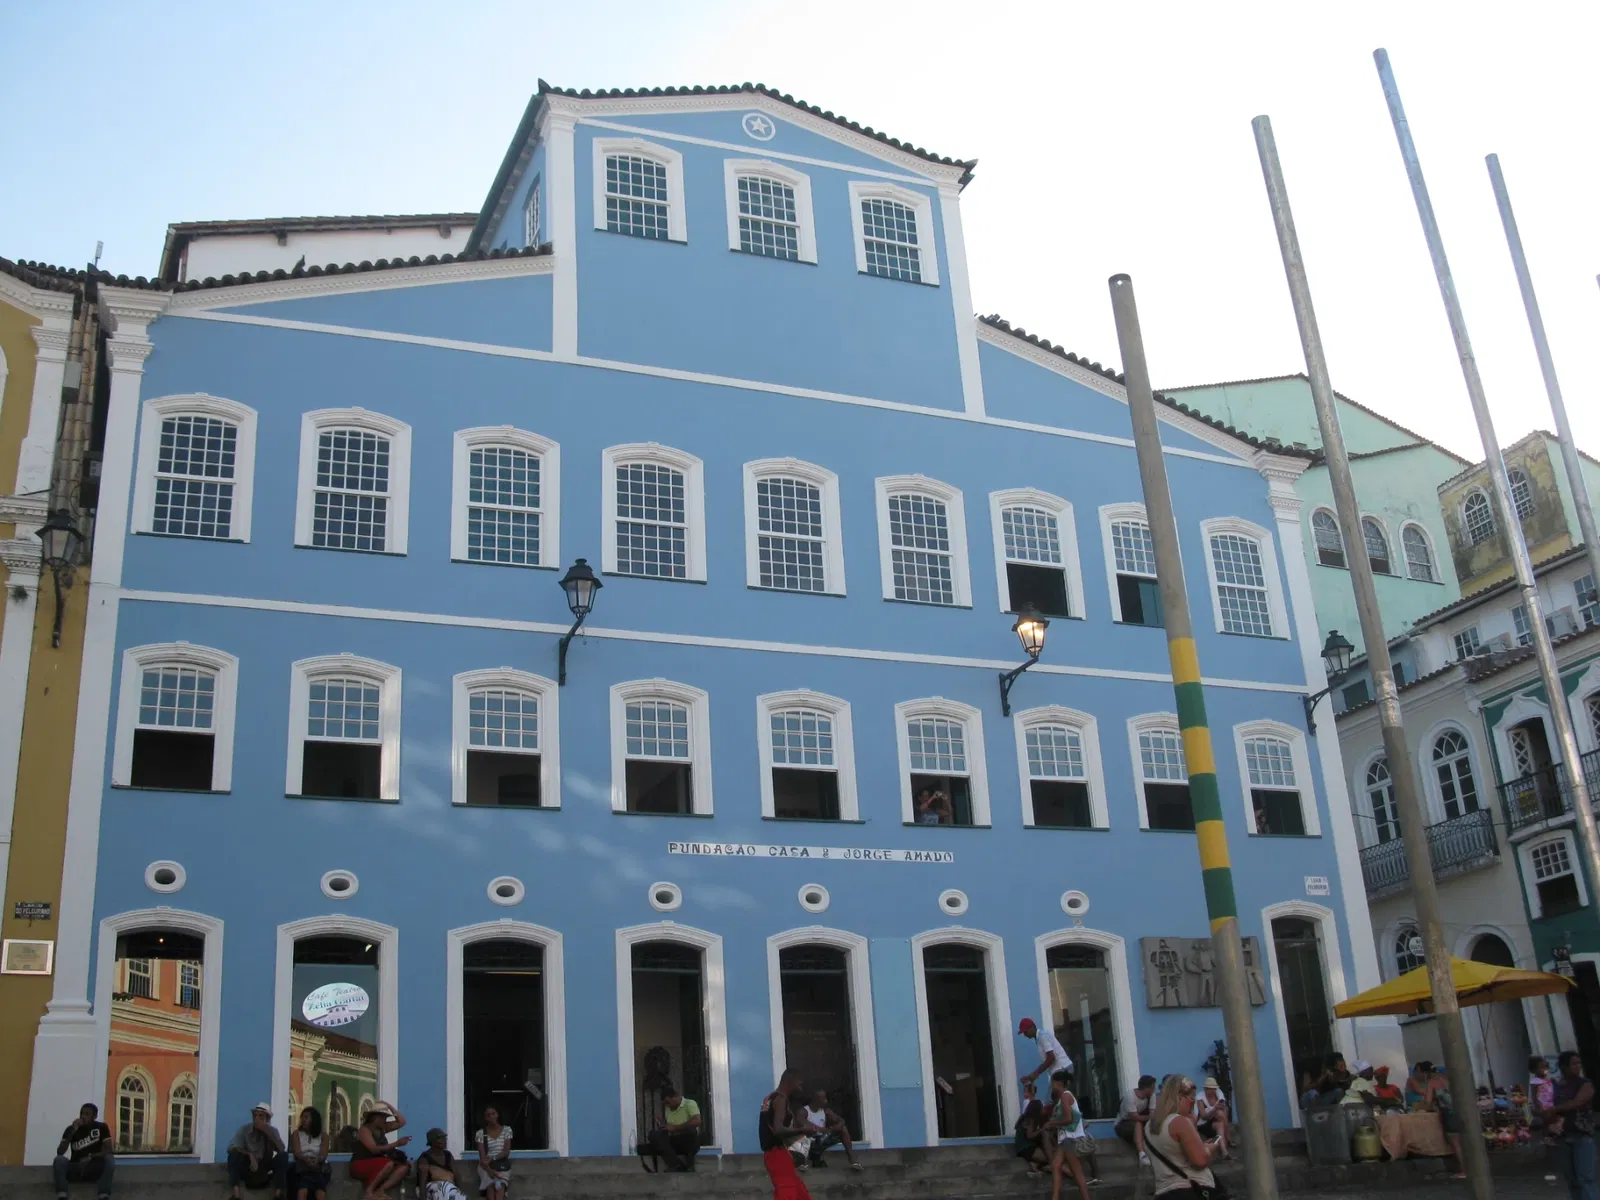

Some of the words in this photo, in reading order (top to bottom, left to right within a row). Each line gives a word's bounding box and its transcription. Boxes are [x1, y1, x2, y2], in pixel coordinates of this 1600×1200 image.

[768, 846, 810, 857] CASA
[843, 848, 892, 860] JORGE
[904, 850, 952, 861] AMADO
